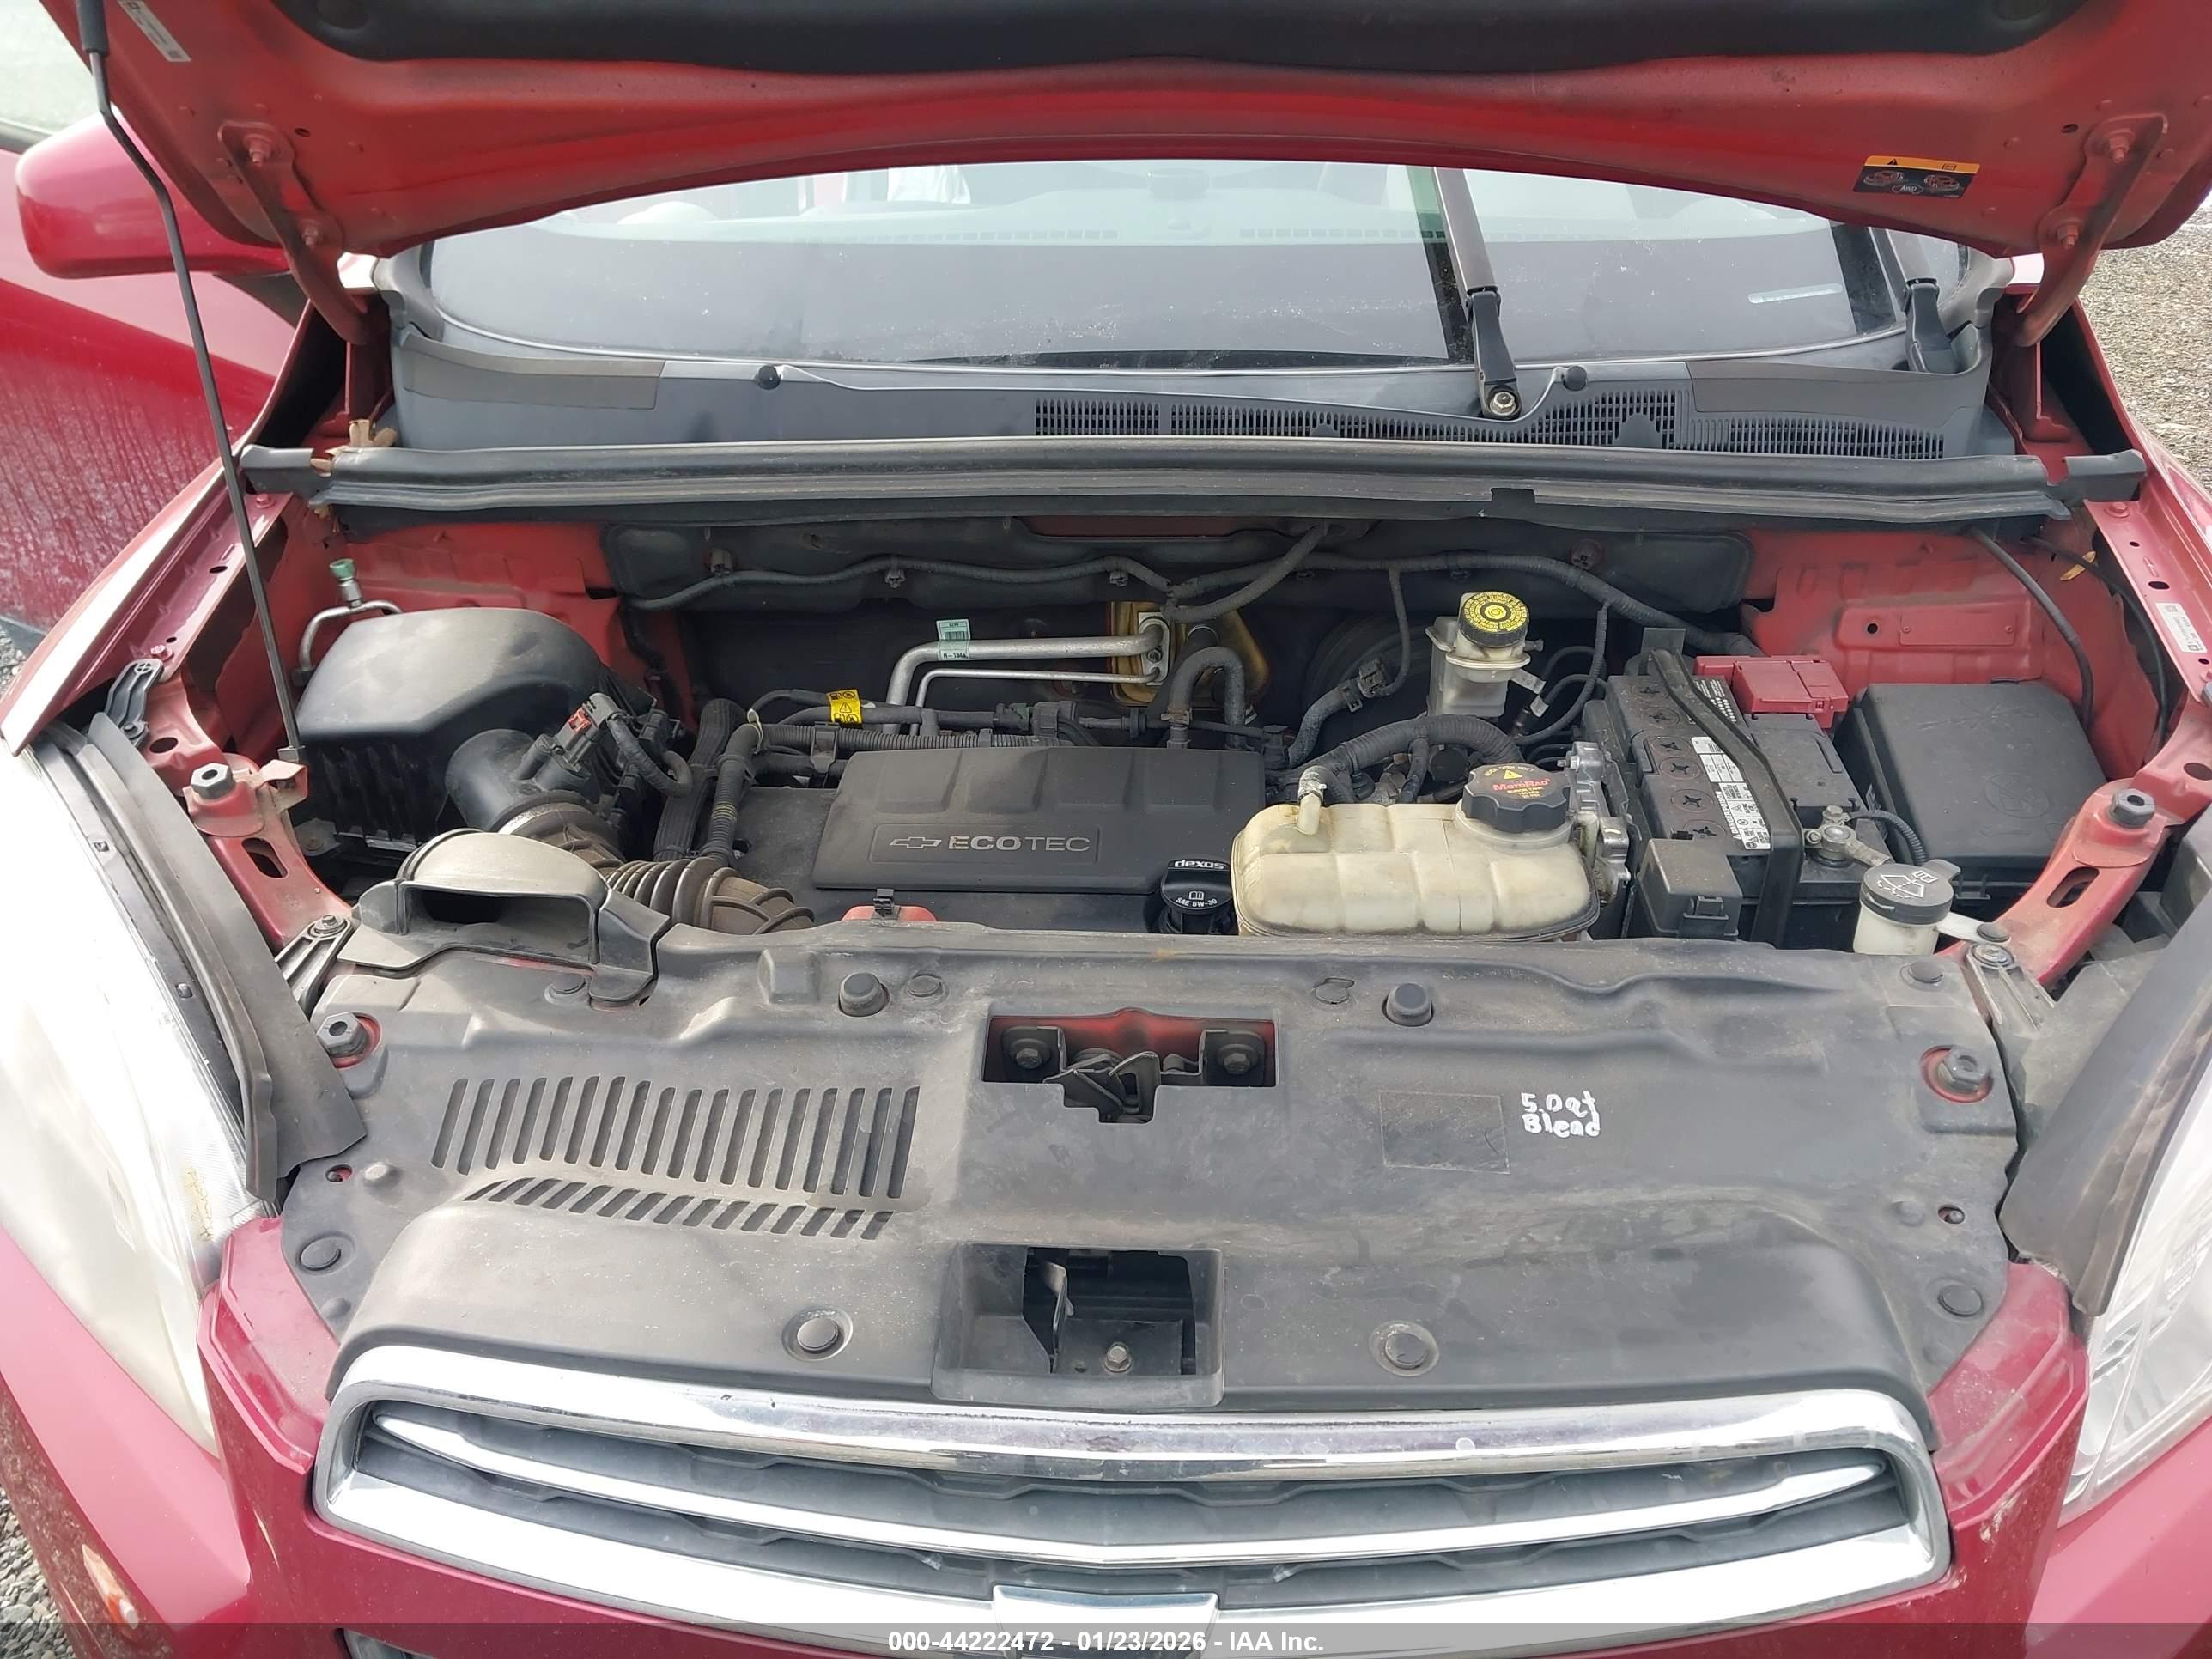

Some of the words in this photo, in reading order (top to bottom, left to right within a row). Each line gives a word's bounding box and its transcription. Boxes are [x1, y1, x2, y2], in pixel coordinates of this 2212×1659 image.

[948, 836, 1091, 852] ECOTEC
[1174, 859, 1227, 870] dexos
[1176, 897, 1190, 907] SAE
[1192, 898, 1218, 908] 5W-30
